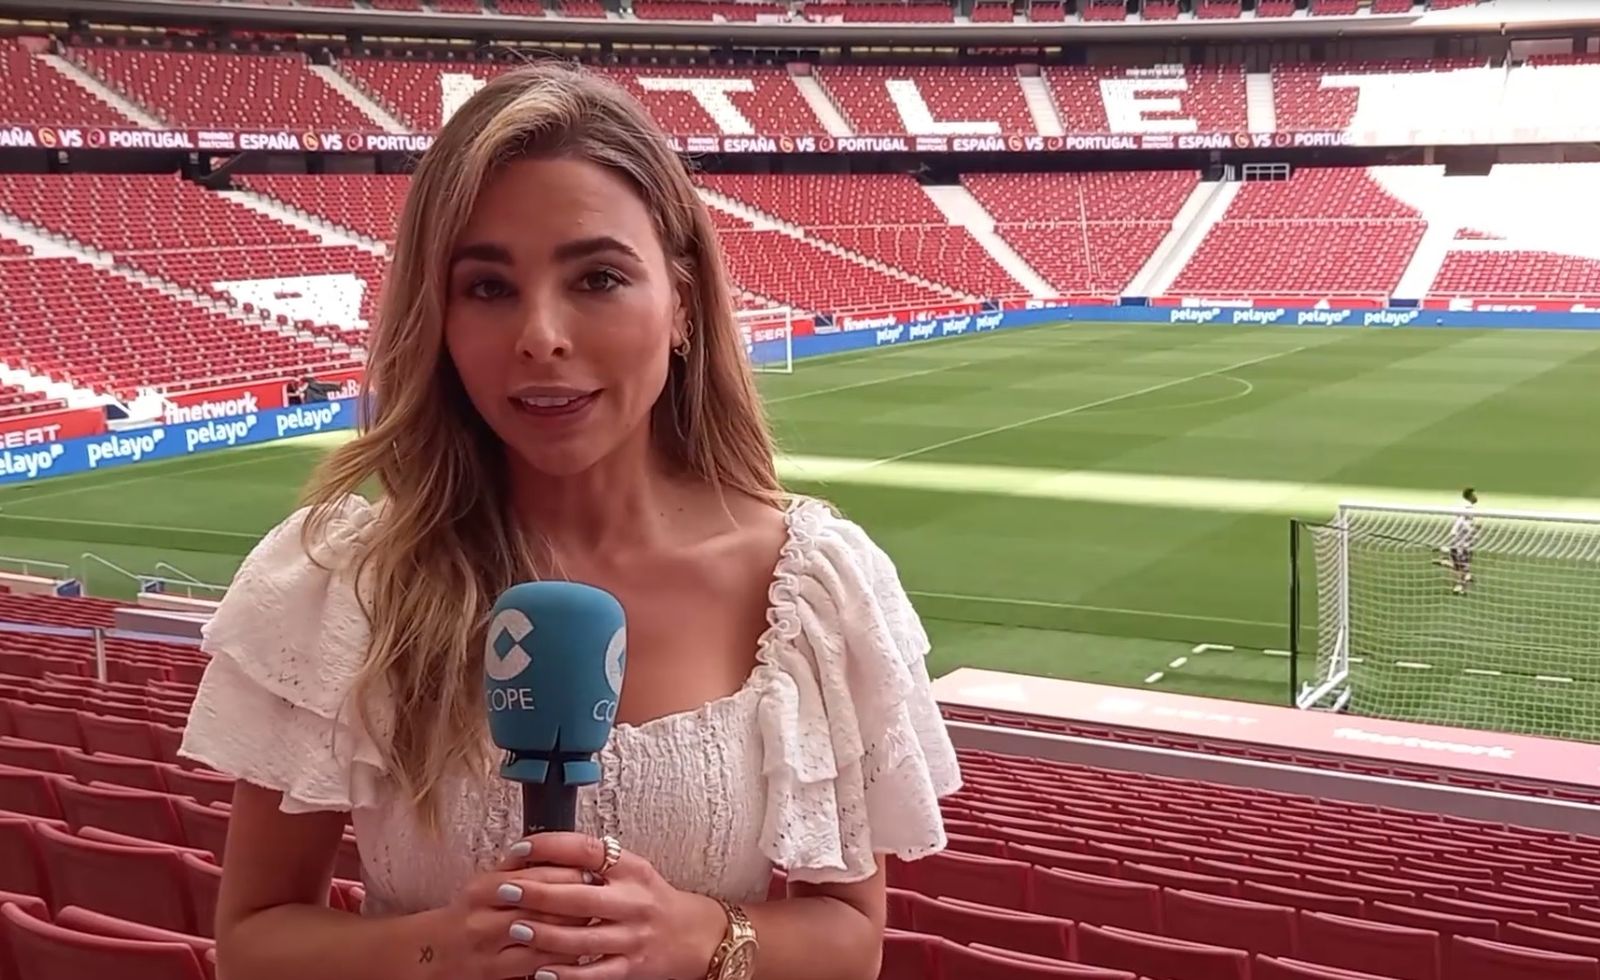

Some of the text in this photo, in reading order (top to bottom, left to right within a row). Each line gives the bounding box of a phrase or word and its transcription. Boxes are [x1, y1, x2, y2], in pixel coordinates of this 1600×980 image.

[0, 127, 37, 148] AÑA
[58, 131, 83, 148] VS
[109, 131, 194, 149] PORTUGAL
[239, 131, 300, 150] ESPAÑA
[321, 135, 343, 150] VS
[724, 135, 777, 152] ESPAÑA
[796, 137, 816, 152] VS
[838, 138, 908, 152] PORTUGAL
[952, 136, 1006, 152] ESPAÑA
[1024, 136, 1044, 151] VS
[1066, 136, 1138, 151] PORTUGAL
[1178, 133, 1232, 149] ESPAÑA
[1251, 134, 1271, 149] VS
[1171, 308, 1410, 327] pelayo pelayo pelayo pelayo
[0, 424, 61, 449] EAT
[87, 435, 155, 468] pelayo
[185, 421, 248, 452] pelayo
[276, 408, 333, 436] pelayo
